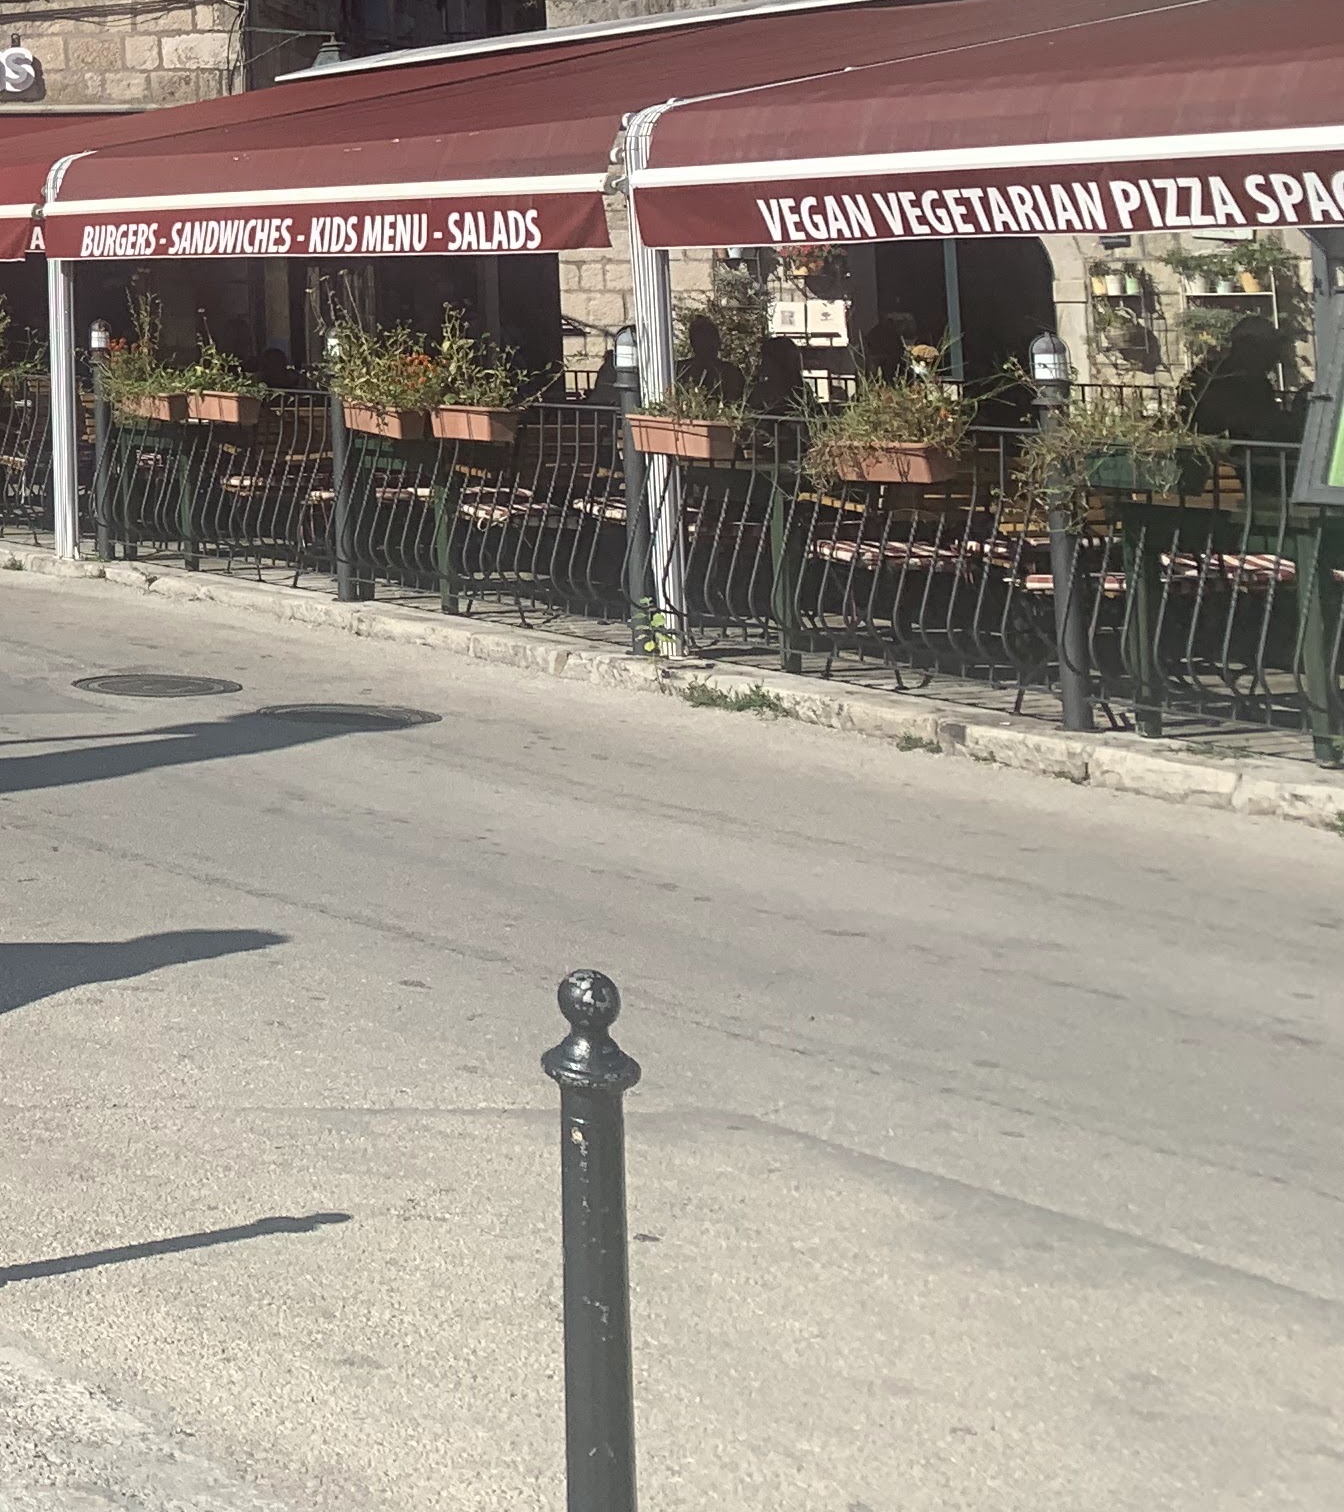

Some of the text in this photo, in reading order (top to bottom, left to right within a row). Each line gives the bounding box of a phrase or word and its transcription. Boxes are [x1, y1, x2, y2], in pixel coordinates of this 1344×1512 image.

[81, 222, 158, 257] BURGERS
[168, 218, 293, 254] SANDWICHES
[308, 215, 359, 253] KIDS
[361, 213, 429, 252] MENU
[447, 209, 542, 251] SALADS
[756, 193, 879, 242] VEGAN
[872, 181, 1109, 237] VEGETARIAN
[1109, 174, 1248, 230] PIZZA
